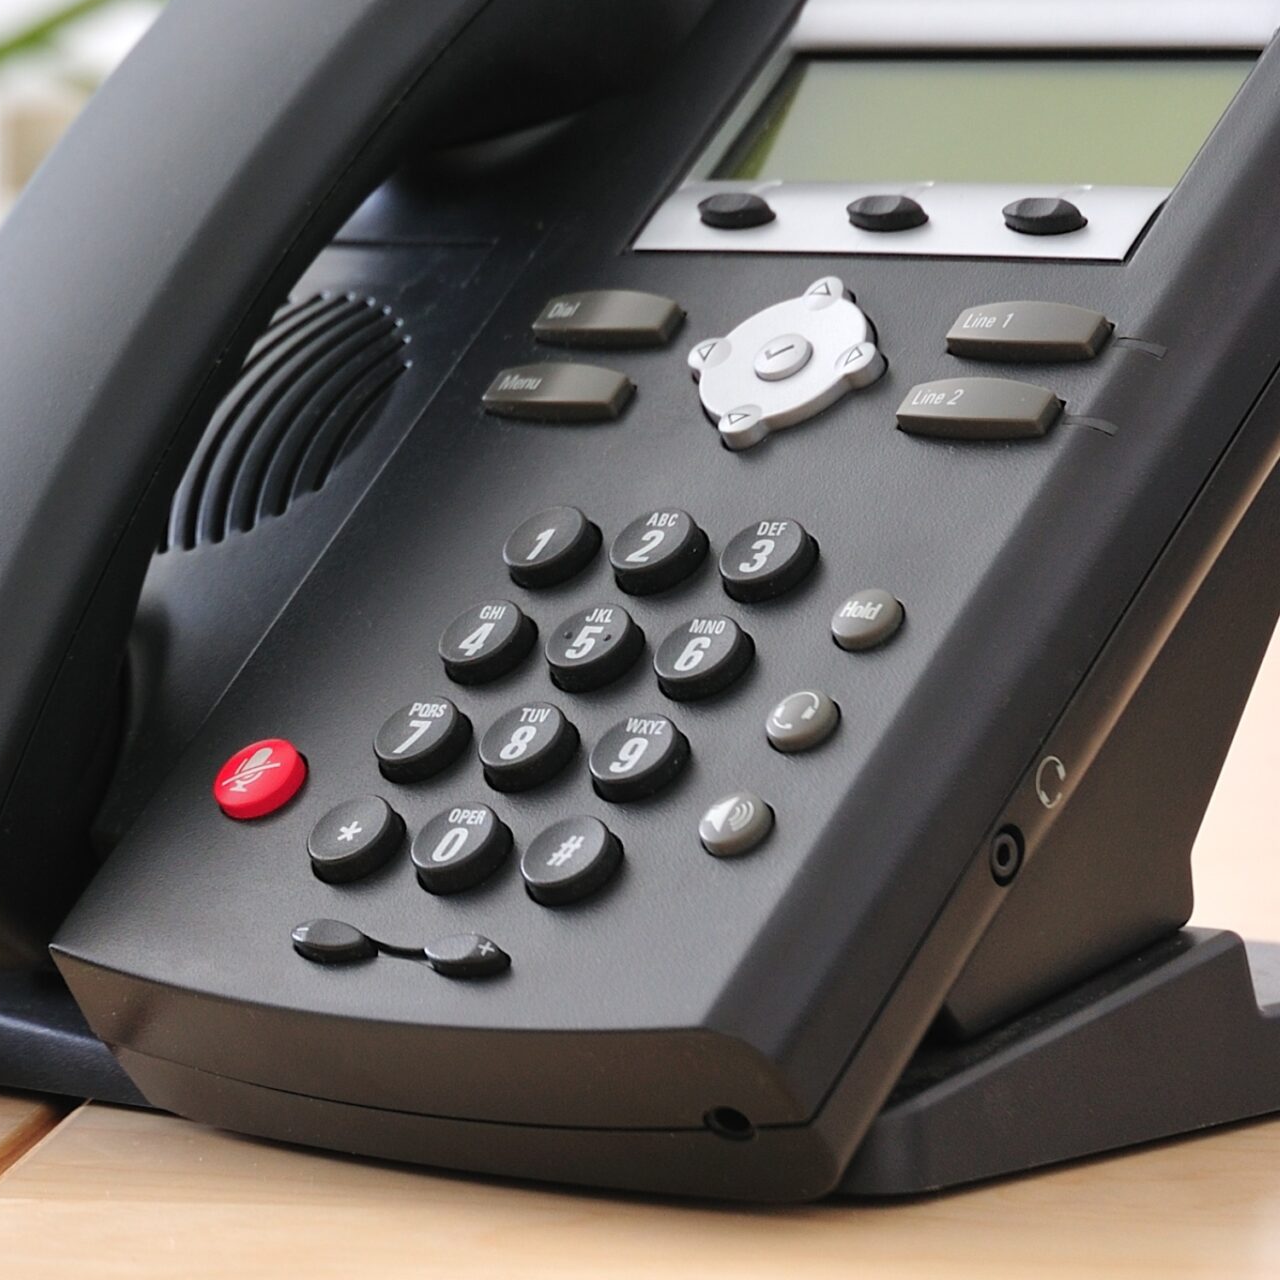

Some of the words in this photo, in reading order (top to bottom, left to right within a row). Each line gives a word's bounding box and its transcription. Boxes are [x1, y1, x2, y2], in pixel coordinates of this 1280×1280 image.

[963, 313, 996, 329] Line
[1001, 313, 1014, 329] 1
[498, 375, 542, 391] Menu
[911, 390, 945, 405] Line
[947, 389, 964, 405] 2
[646, 512, 679, 527] ABC
[757, 522, 787, 536] DEF
[526, 529, 556, 560] 1
[625, 530, 665, 562] 2
[739, 539, 775, 572] 3
[480, 605, 506, 620] GHI
[585, 608, 614, 623] JKL
[840, 601, 882, 620] Hold
[689, 619, 726, 635] MNO
[458, 622, 495, 656] 4
[565, 626, 603, 659] 5
[674, 637, 711, 671] 6
[409, 702, 447, 718] PQRS
[520, 708, 551, 723] TUV
[626, 718, 667, 735] WXYZ
[393, 720, 432, 754] 7
[499, 726, 537, 760] 8
[609, 737, 648, 773] 9
[448, 808, 486, 825] OPER
[431, 827, 468, 862] 0
